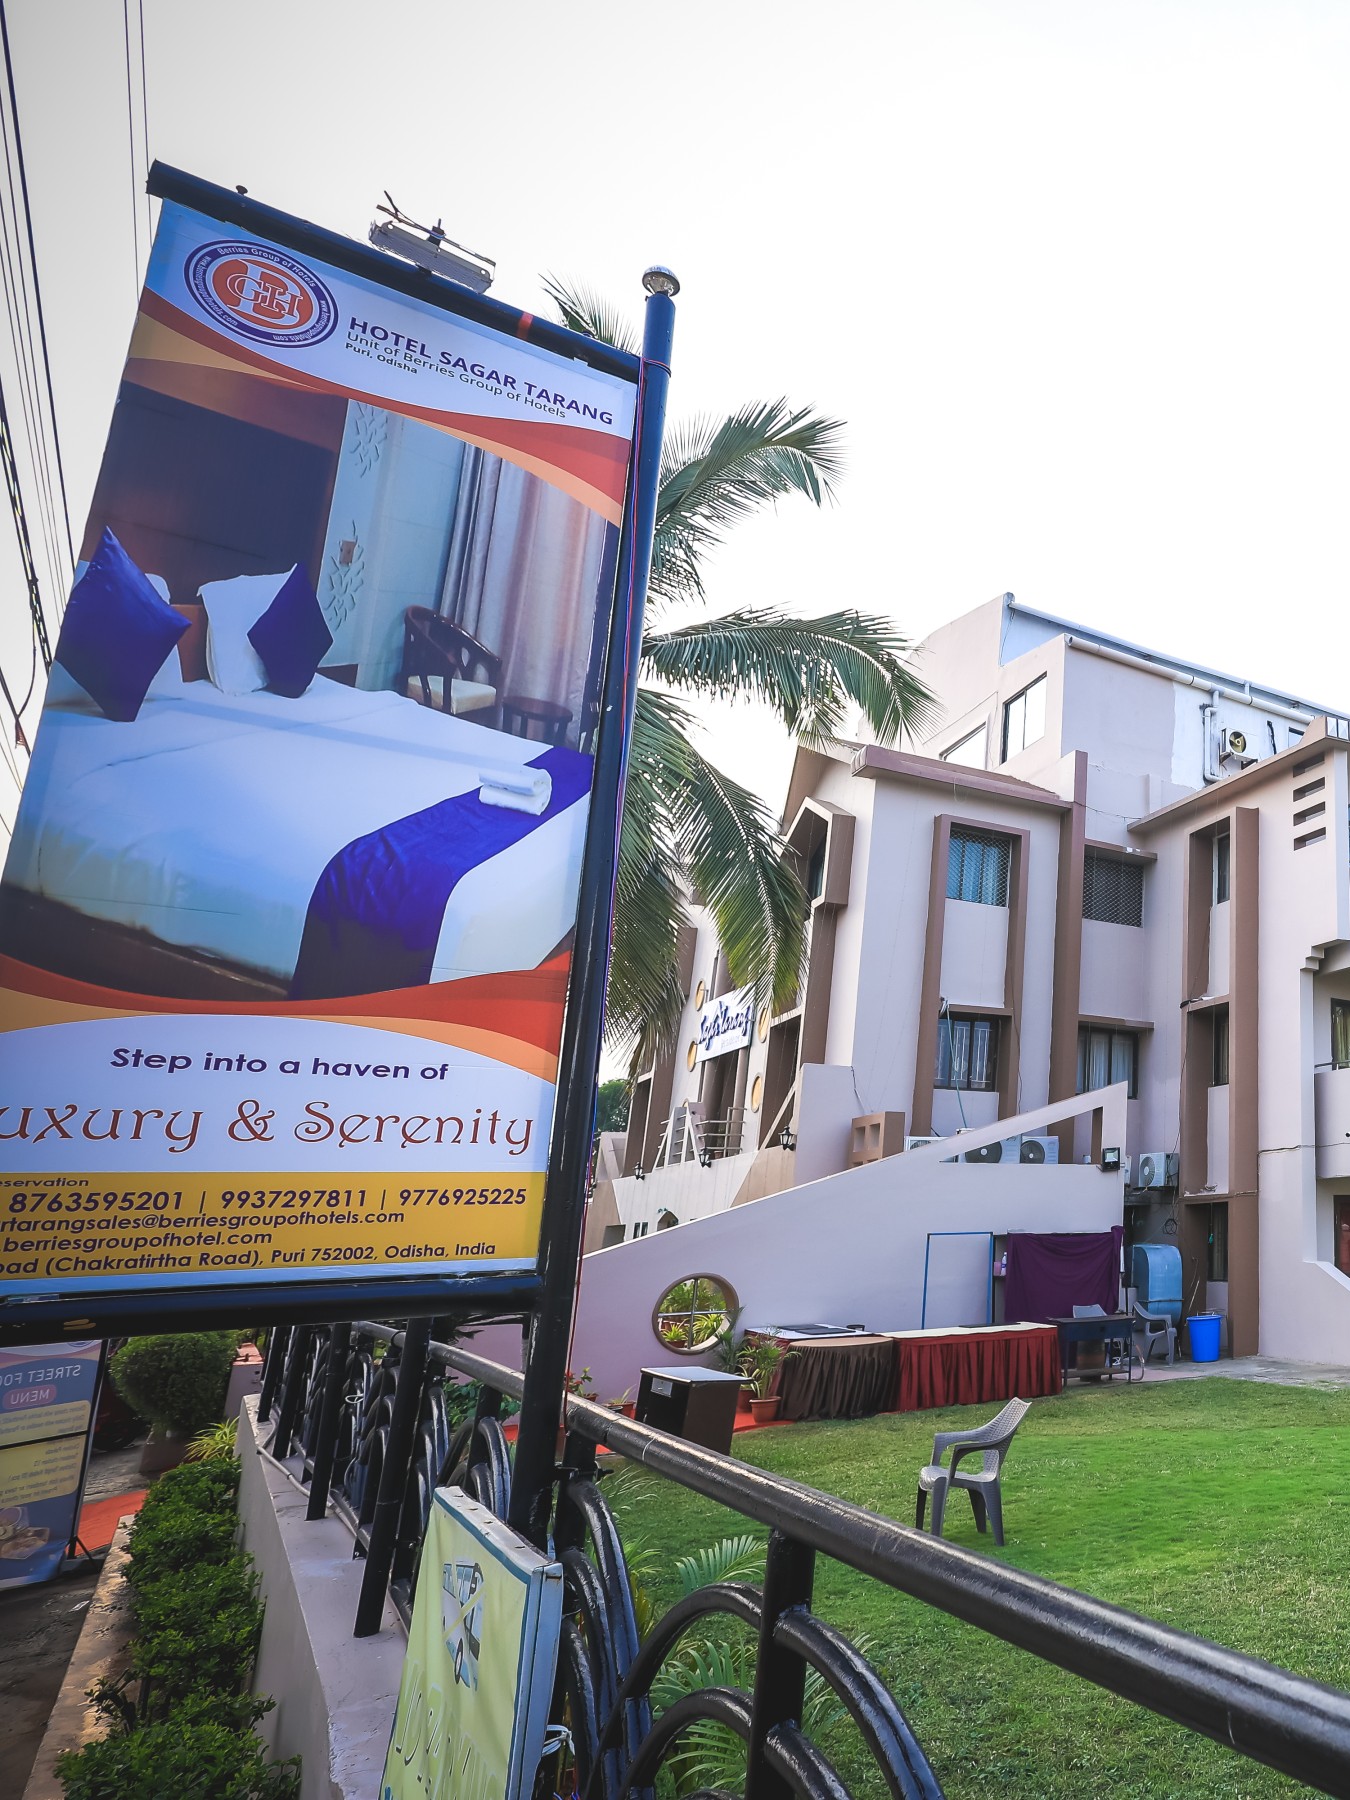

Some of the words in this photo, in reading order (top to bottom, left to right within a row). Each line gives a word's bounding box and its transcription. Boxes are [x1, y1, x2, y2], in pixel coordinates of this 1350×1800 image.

[217, 245, 249, 255] Berries
[251, 248, 280, 263] Group
[282, 259, 293, 268] of
[293, 266, 316, 288] Hotels
[347, 331, 381, 351] Unit
[384, 347, 401, 357] of
[403, 352, 456, 378] Berries
[459, 373, 503, 396] Group
[506, 391, 522, 402] of
[524, 396, 566, 418] Hotels
[349, 316, 432, 359] HOTEL
[438, 351, 517, 391] SAGAR
[523, 381, 614, 425] TARANG
[376, 354, 418, 374] Odisha
[110, 1048, 192, 1074] Step
[203, 1052, 267, 1073] into
[279, 1060, 300, 1075] a
[312, 1057, 410, 1079] haven
[420, 1063, 449, 1080] of
[227, 1099, 275, 1142] &
[294, 1101, 534, 1156] Serenity
[0, 1177, 89, 1187] servation
[8, 1191, 183, 1214] 8763595201
[221, 1189, 366, 1209] 9937297811
[399, 1188, 527, 1206] 9776925225
[46, 1254, 192, 1275] (Chakratirtha
[199, 1250, 264, 1268] Road),
[271, 1248, 305, 1263] Puri
[311, 1246, 378, 1261] 752002,
[384, 1244, 449, 1259] Odisha,
[455, 1242, 496, 1256] India
